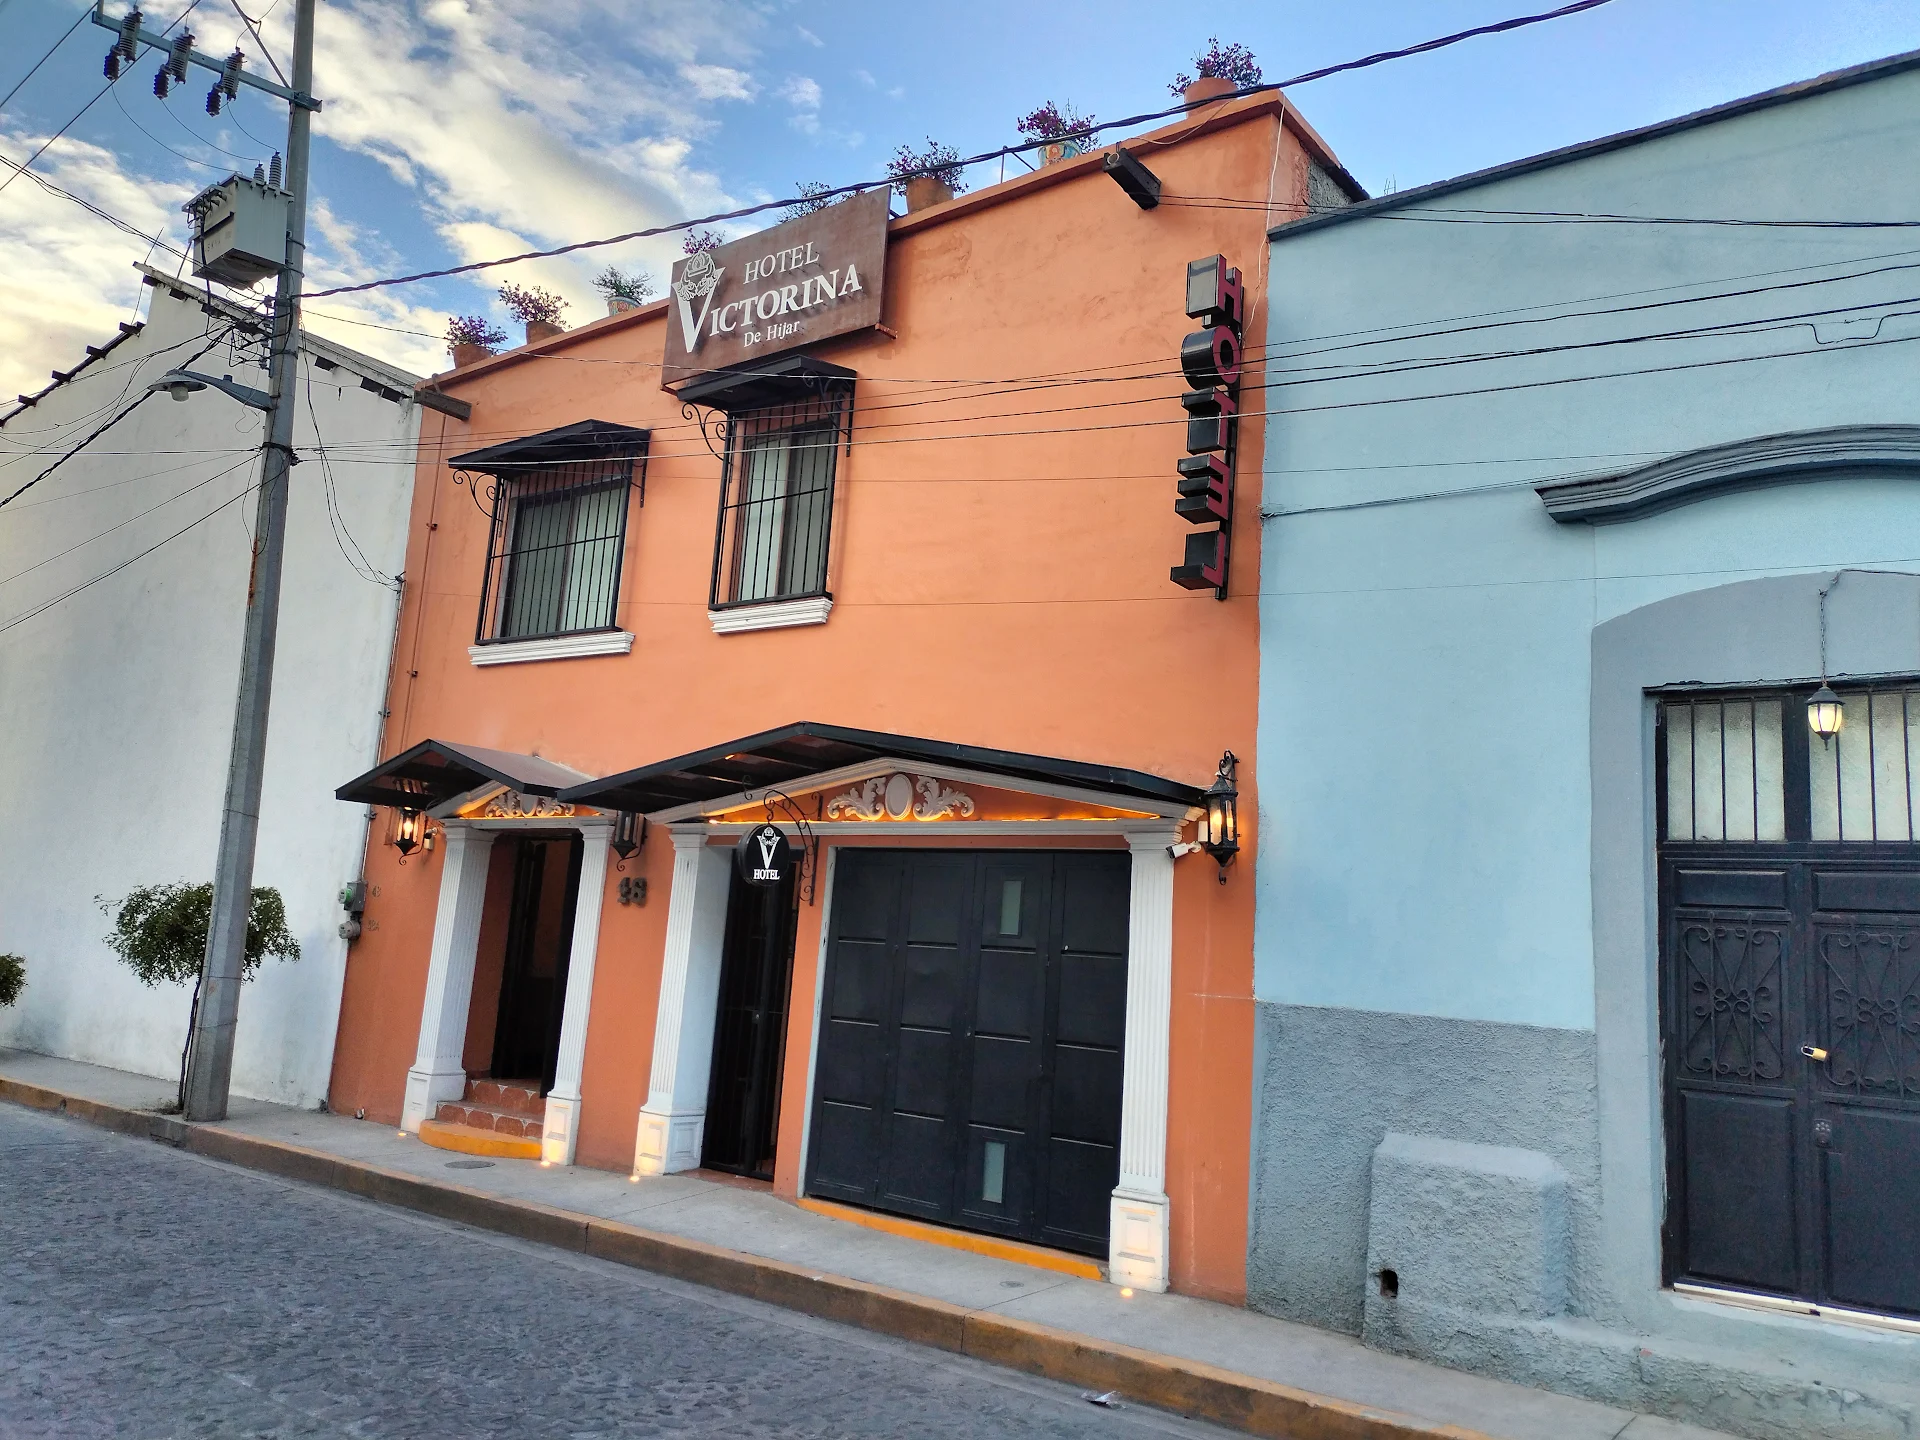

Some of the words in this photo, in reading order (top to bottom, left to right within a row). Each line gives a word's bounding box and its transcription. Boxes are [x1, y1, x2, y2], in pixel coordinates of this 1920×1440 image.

[743, 241, 820, 285] HOTEL
[672, 263, 863, 353] VICTORINA
[743, 330, 762, 348] De
[767, 320, 801, 342] Hijar
[1170, 253, 1242, 591] HOTEL
[753, 868, 781, 880] HOTEL
